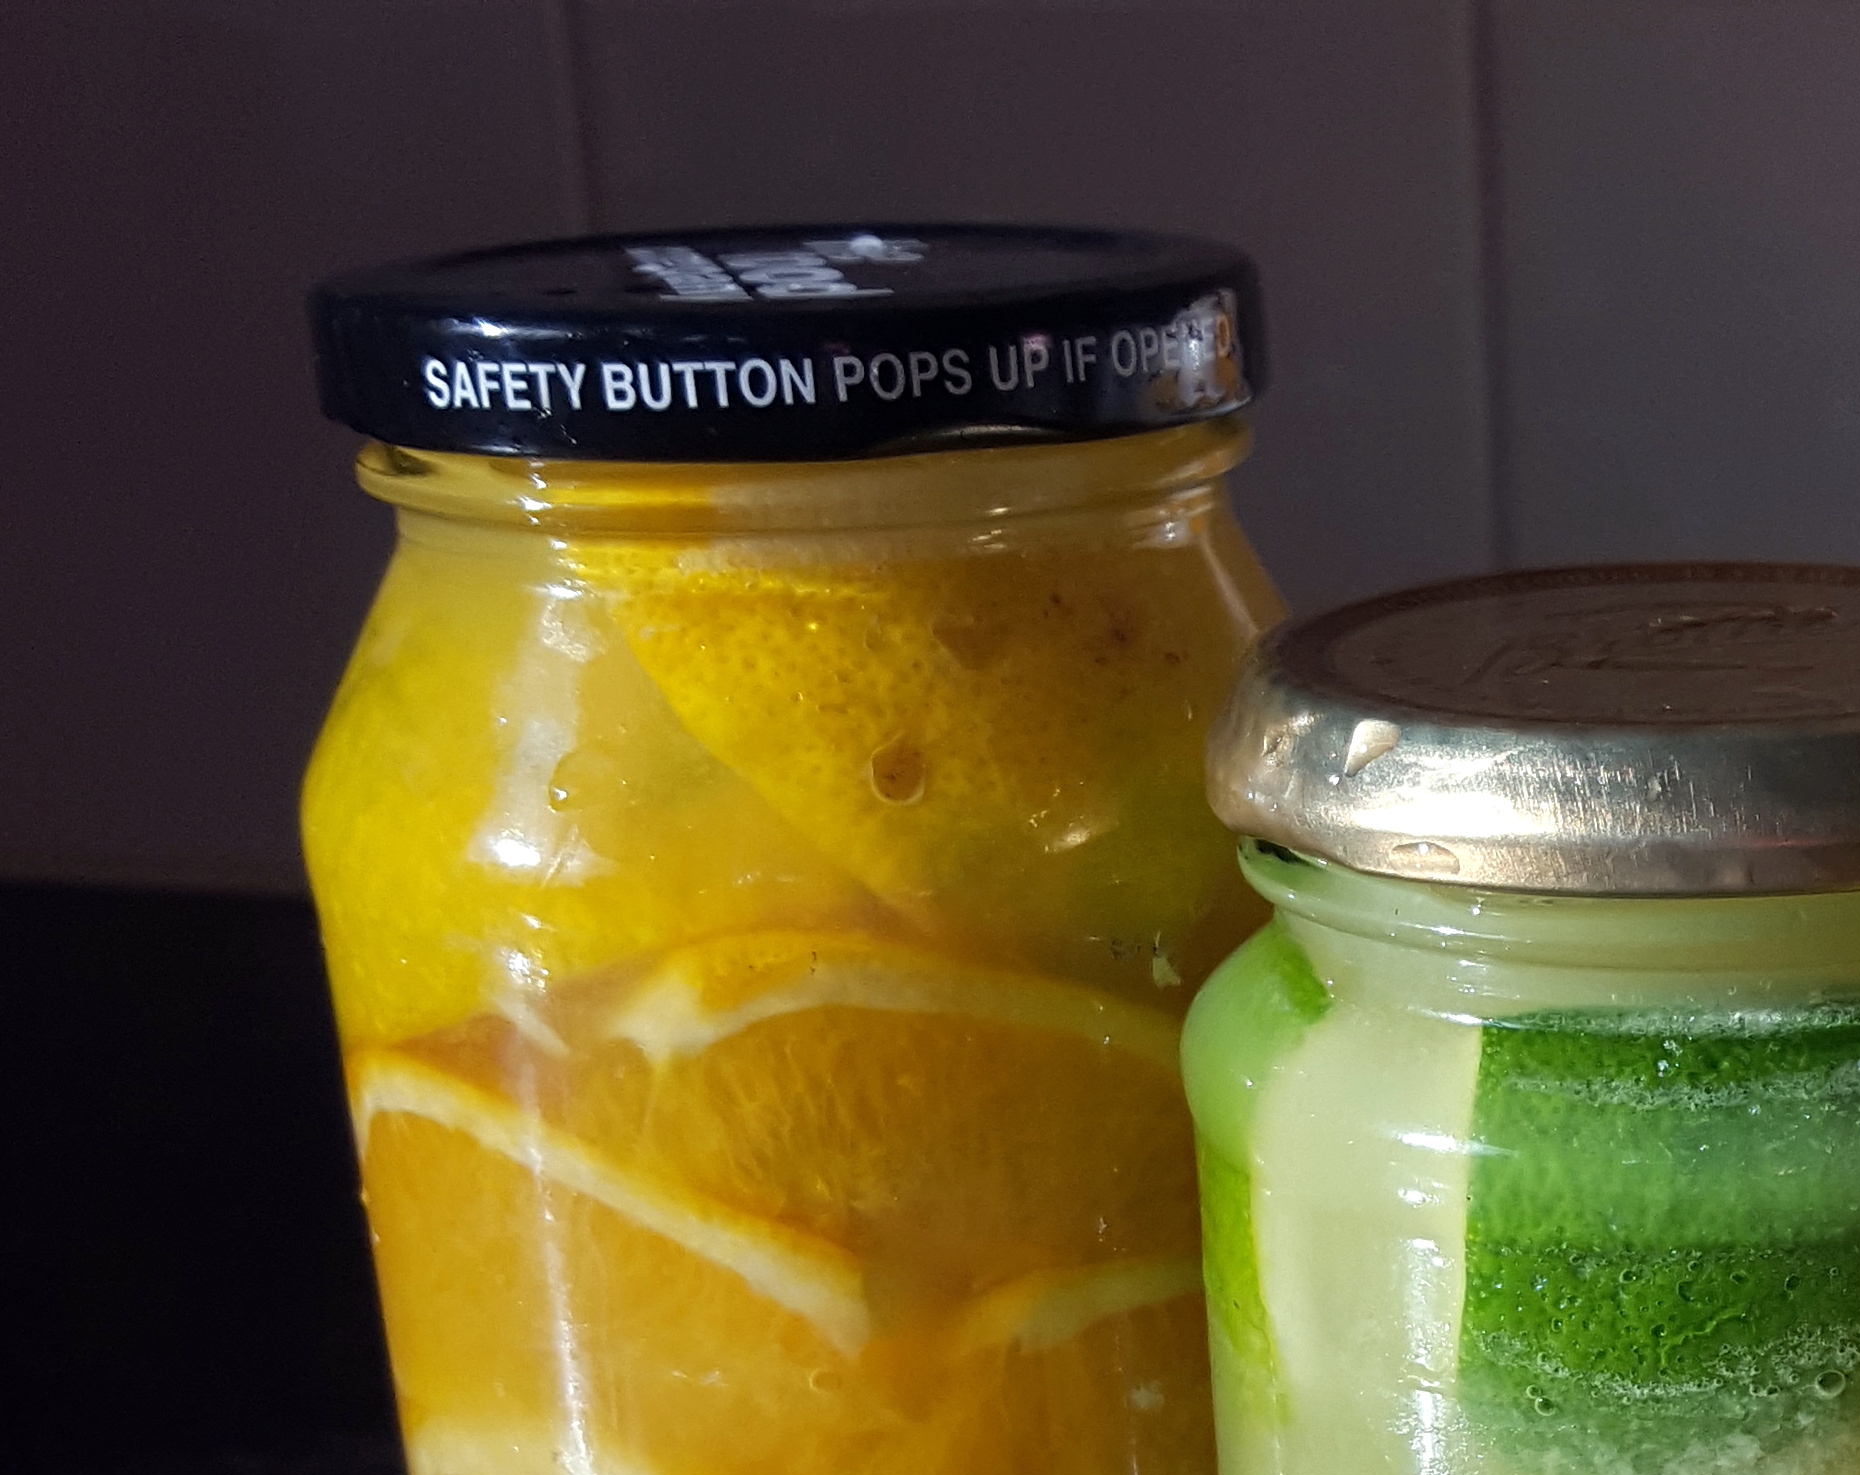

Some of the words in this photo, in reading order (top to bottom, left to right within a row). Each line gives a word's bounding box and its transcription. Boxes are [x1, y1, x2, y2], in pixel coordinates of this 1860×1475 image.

[423, 358, 587, 410] SAFETY
[601, 357, 817, 411] BUTTON
[833, 348, 973, 403] POPS
[988, 333, 1051, 392] UP
[1062, 335, 1097, 384] IF
